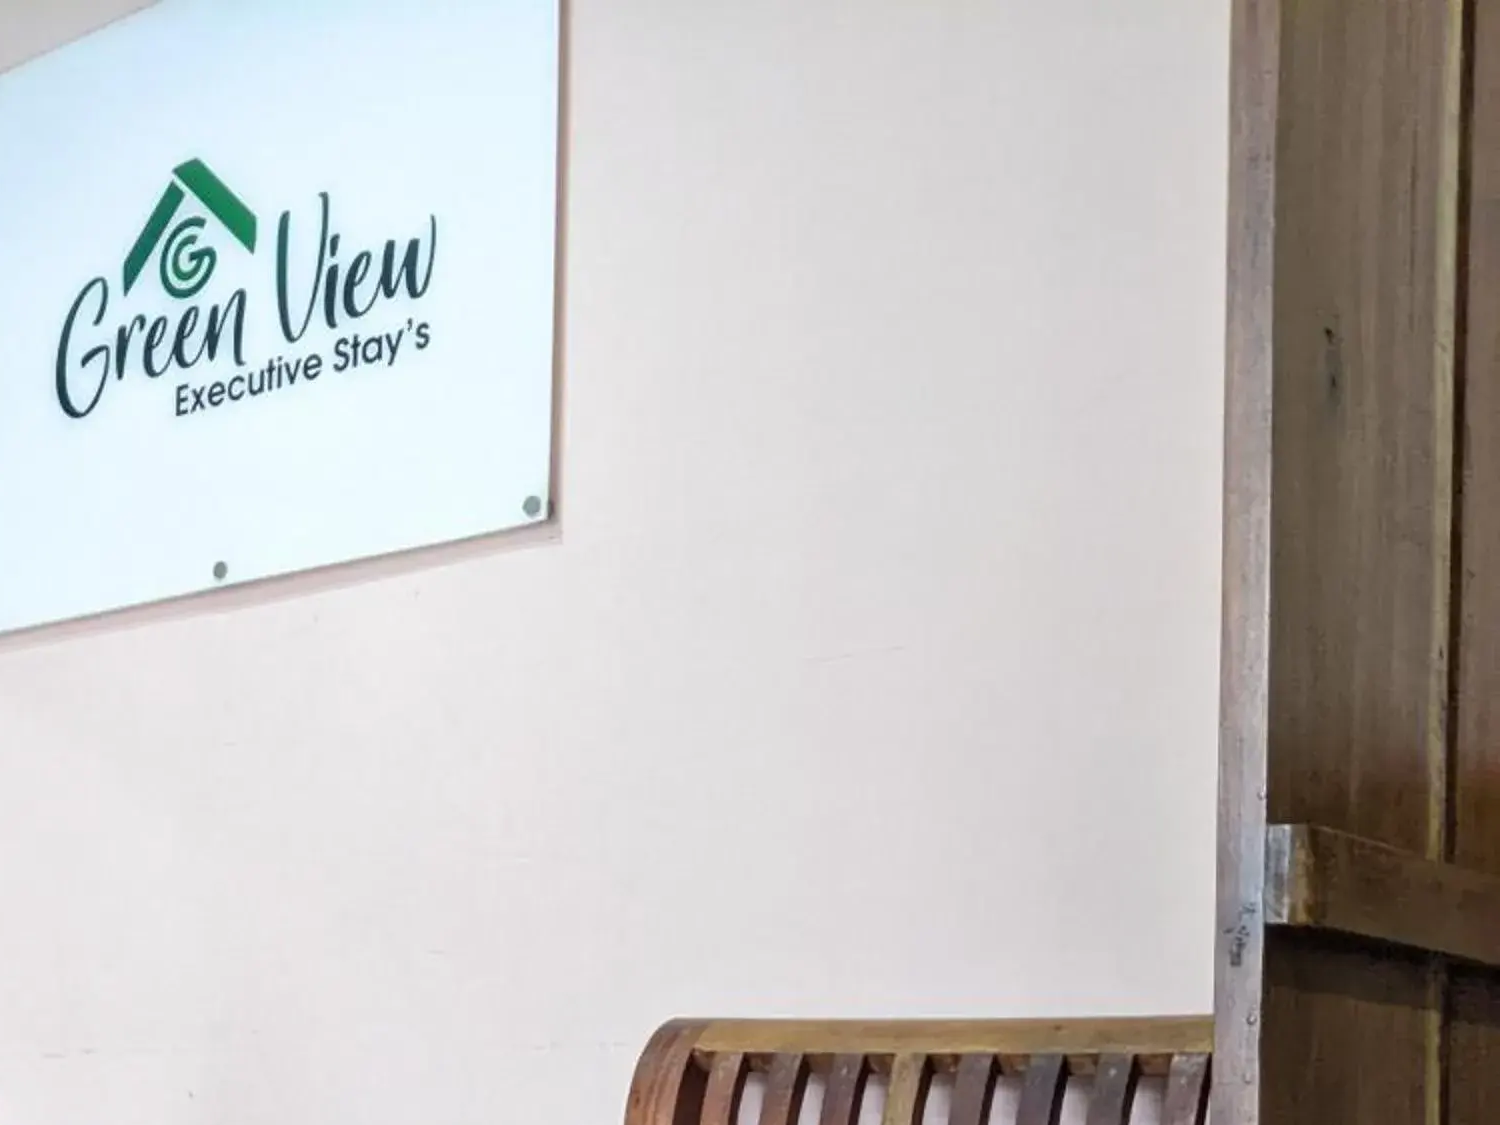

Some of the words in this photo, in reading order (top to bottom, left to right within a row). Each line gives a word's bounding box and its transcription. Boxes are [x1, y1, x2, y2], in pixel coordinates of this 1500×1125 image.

[56, 277, 247, 418] Green
[276, 191, 436, 343] View
[175, 353, 322, 416] Executive
[333, 318, 431, 373] Stay's
